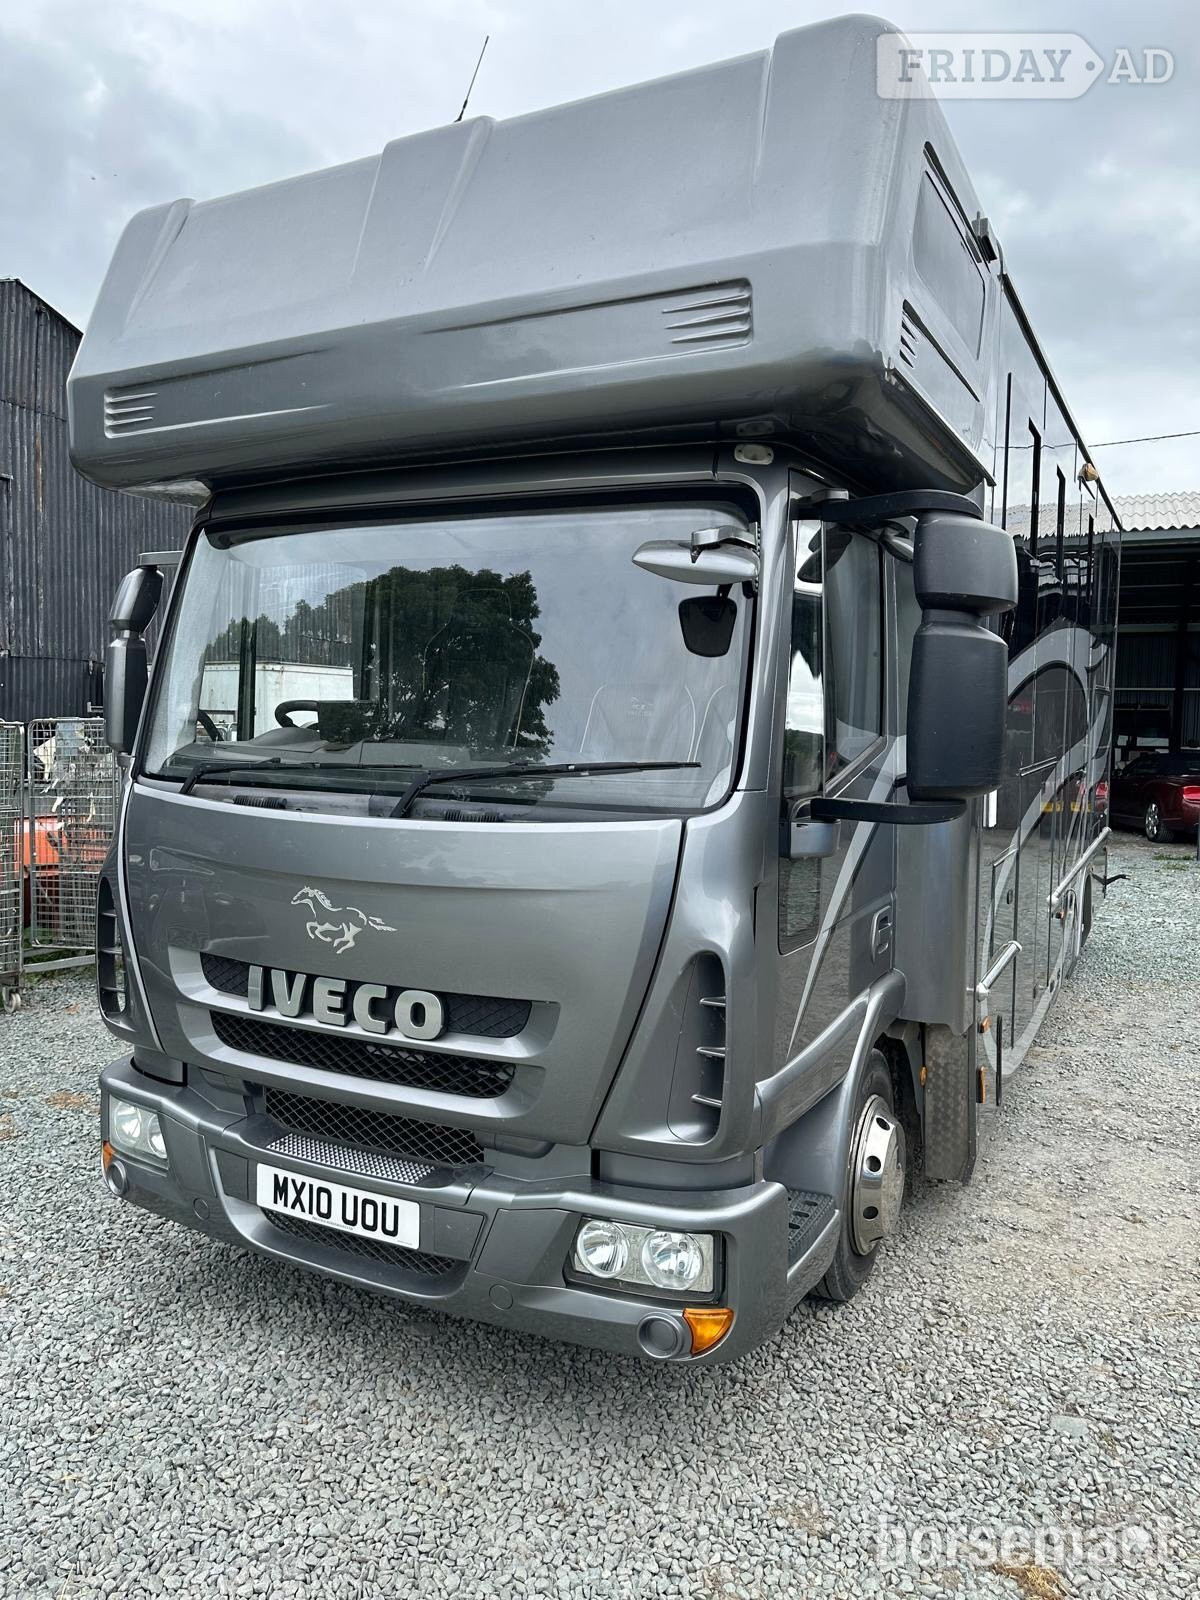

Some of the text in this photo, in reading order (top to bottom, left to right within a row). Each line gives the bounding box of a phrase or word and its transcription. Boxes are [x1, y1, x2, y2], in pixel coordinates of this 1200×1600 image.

[248, 965, 444, 1041] IVECO
[273, 1174, 399, 1238] MX10 UOU
